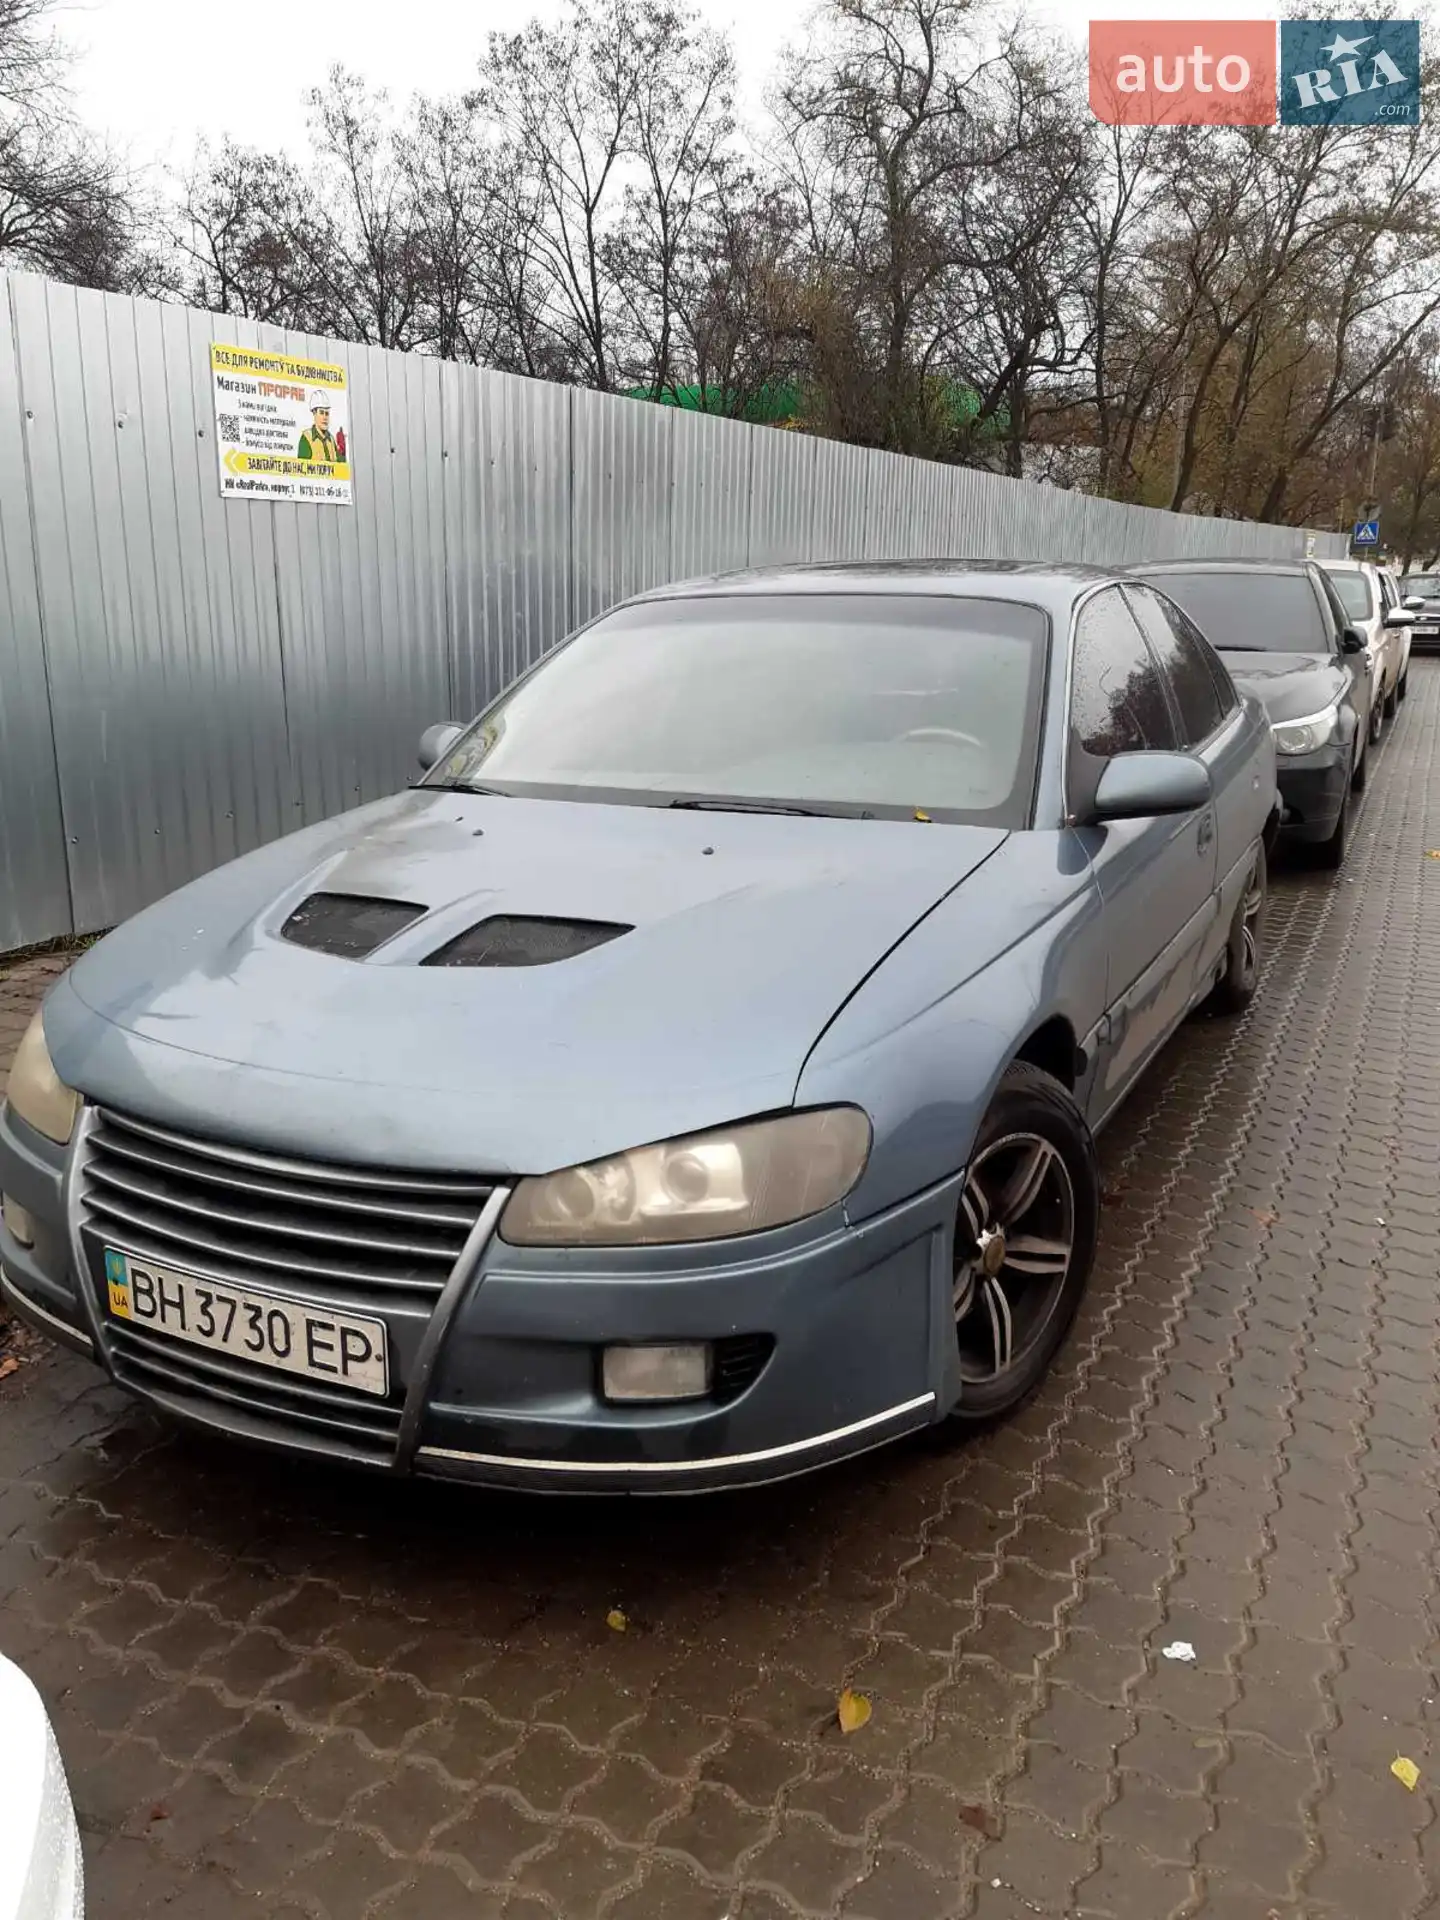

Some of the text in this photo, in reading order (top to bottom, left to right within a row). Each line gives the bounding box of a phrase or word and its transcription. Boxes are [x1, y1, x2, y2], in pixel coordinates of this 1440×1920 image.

[215, 350, 230, 365] ВСЕ
[231, 353, 248, 368] ДЛЯ
[249, 356, 285, 373] РЕМОНТУ
[286, 362, 296, 376] ТА
[216, 375, 306, 402] Магазин ПРОРАБ
[113, 1292, 128, 1308] UA
[130, 1267, 373, 1376] BH 3730 EP
